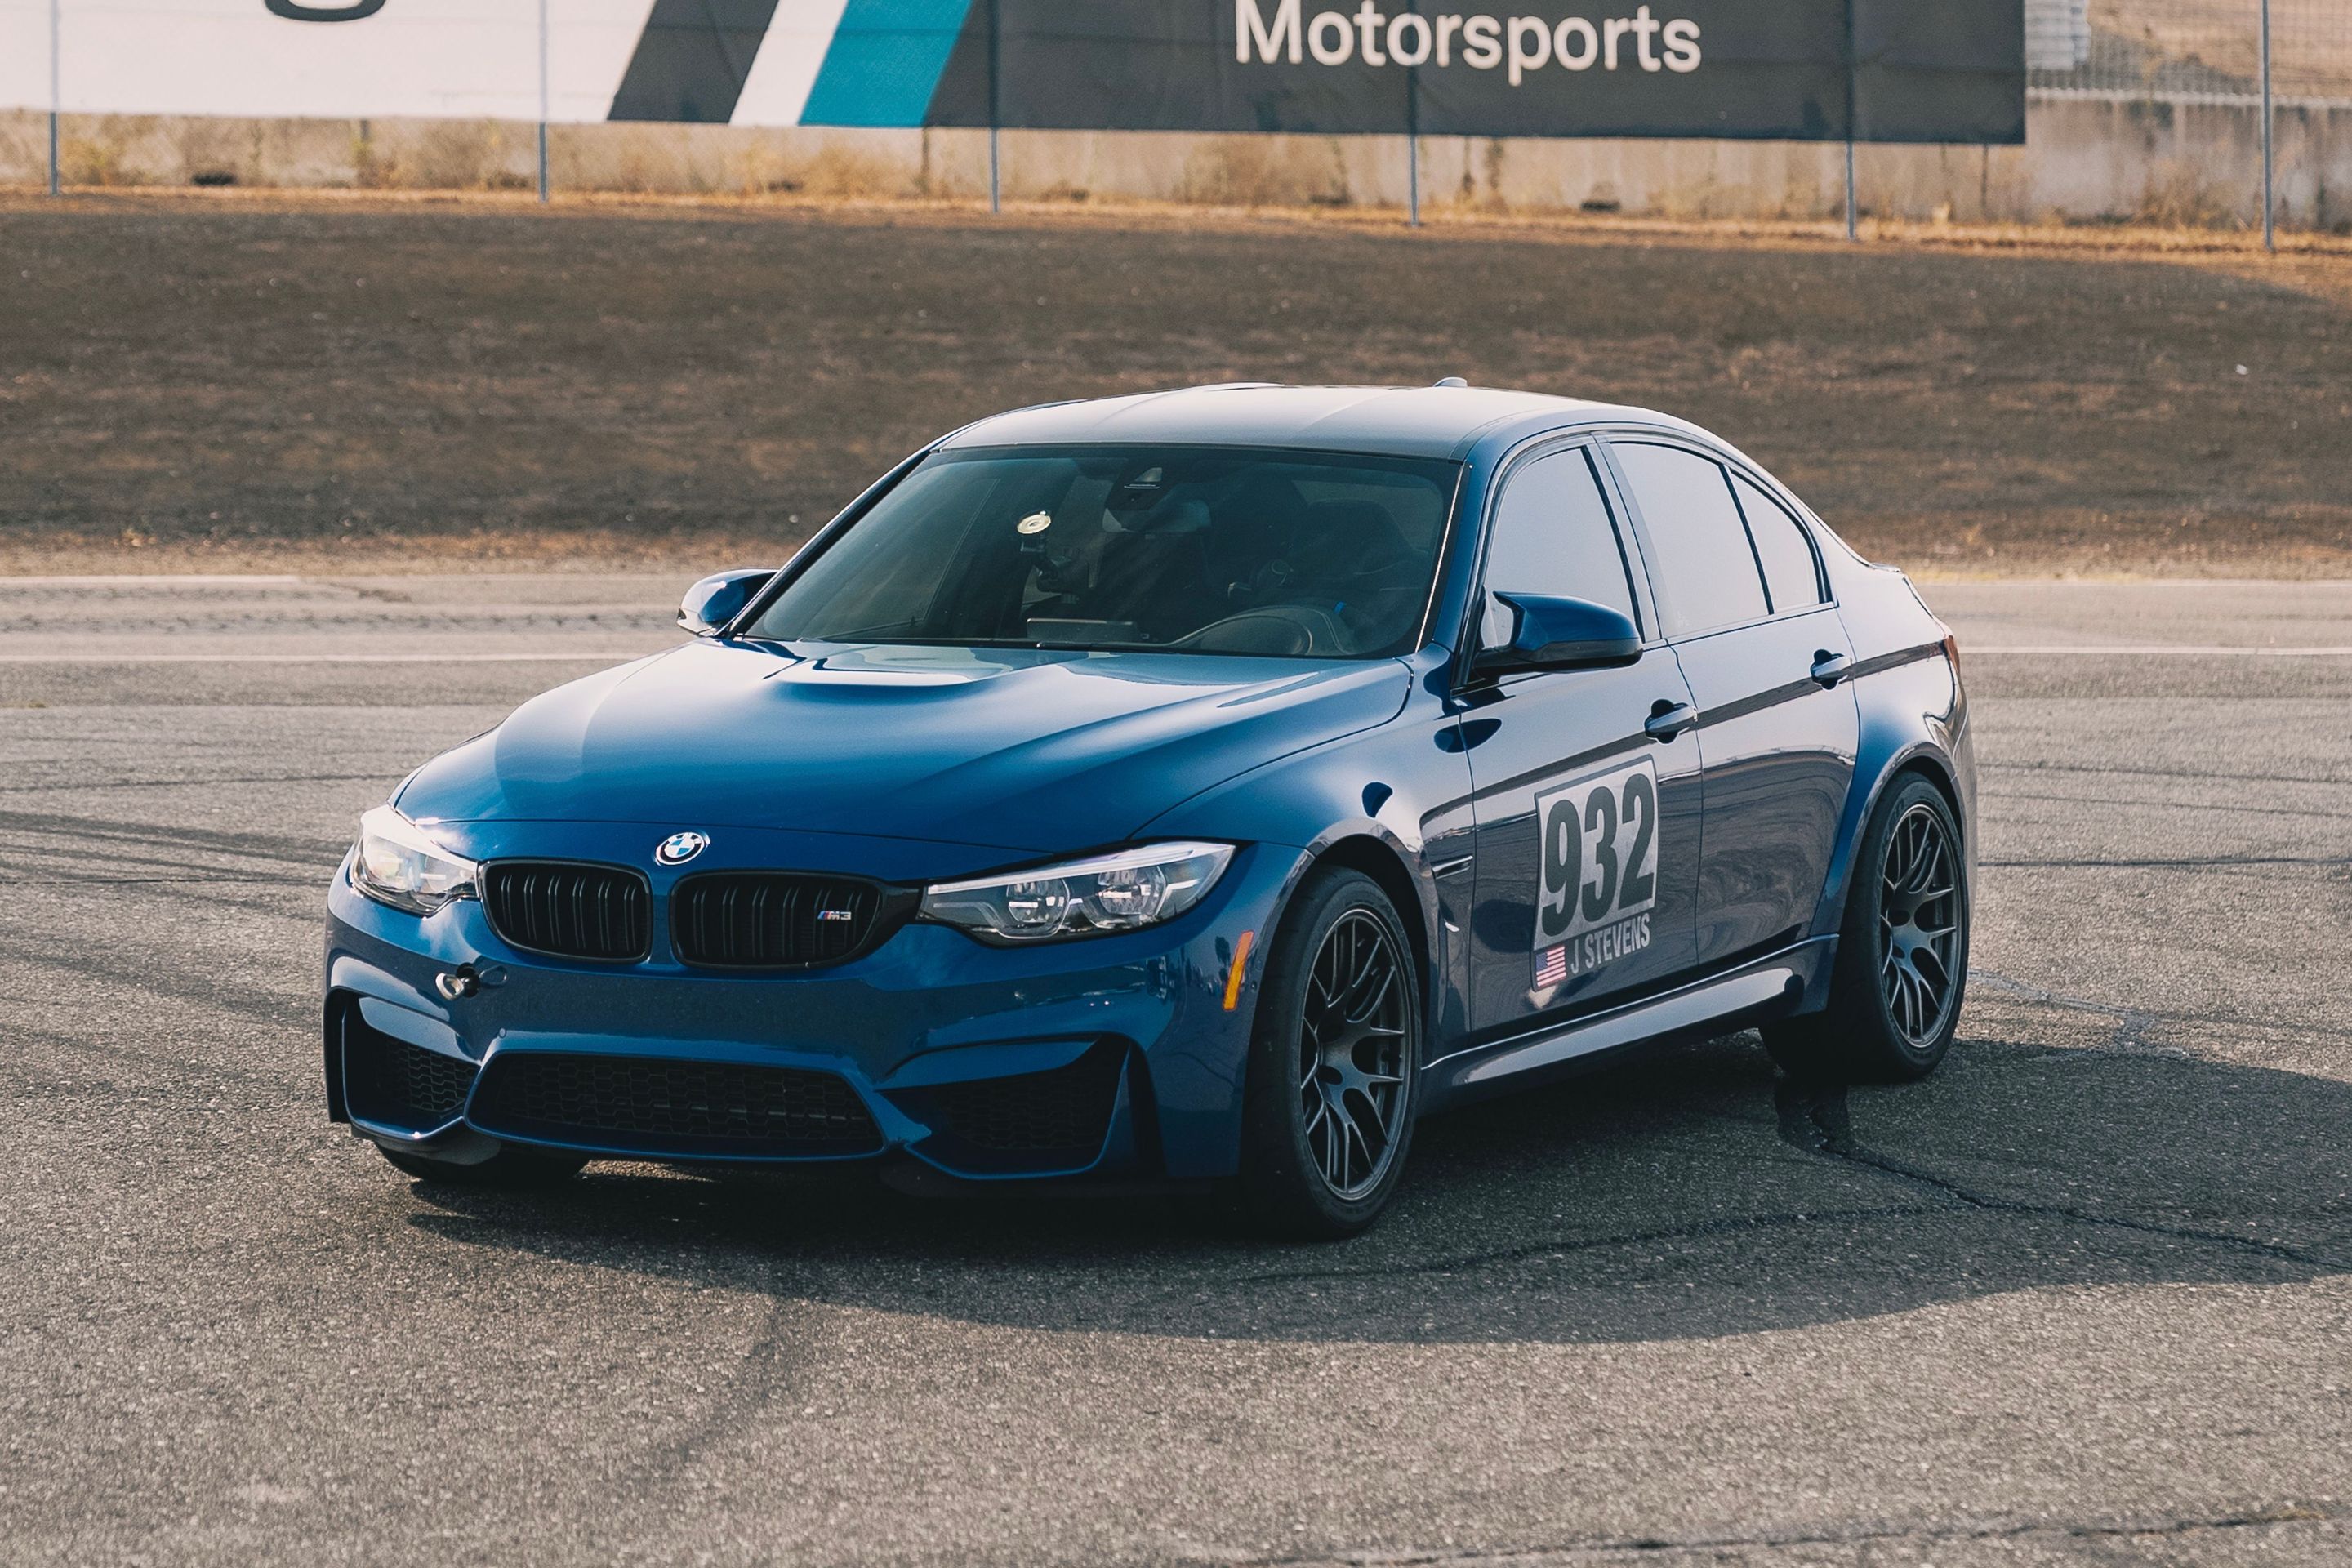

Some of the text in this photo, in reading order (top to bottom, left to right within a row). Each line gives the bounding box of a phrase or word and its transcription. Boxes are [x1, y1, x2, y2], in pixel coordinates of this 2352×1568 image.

[1236, 0, 1702, 86] Motorsports
[1542, 773, 1655, 937] 932
[826, 911, 851, 920] M3
[1570, 913, 1650, 974] J STEVENS
